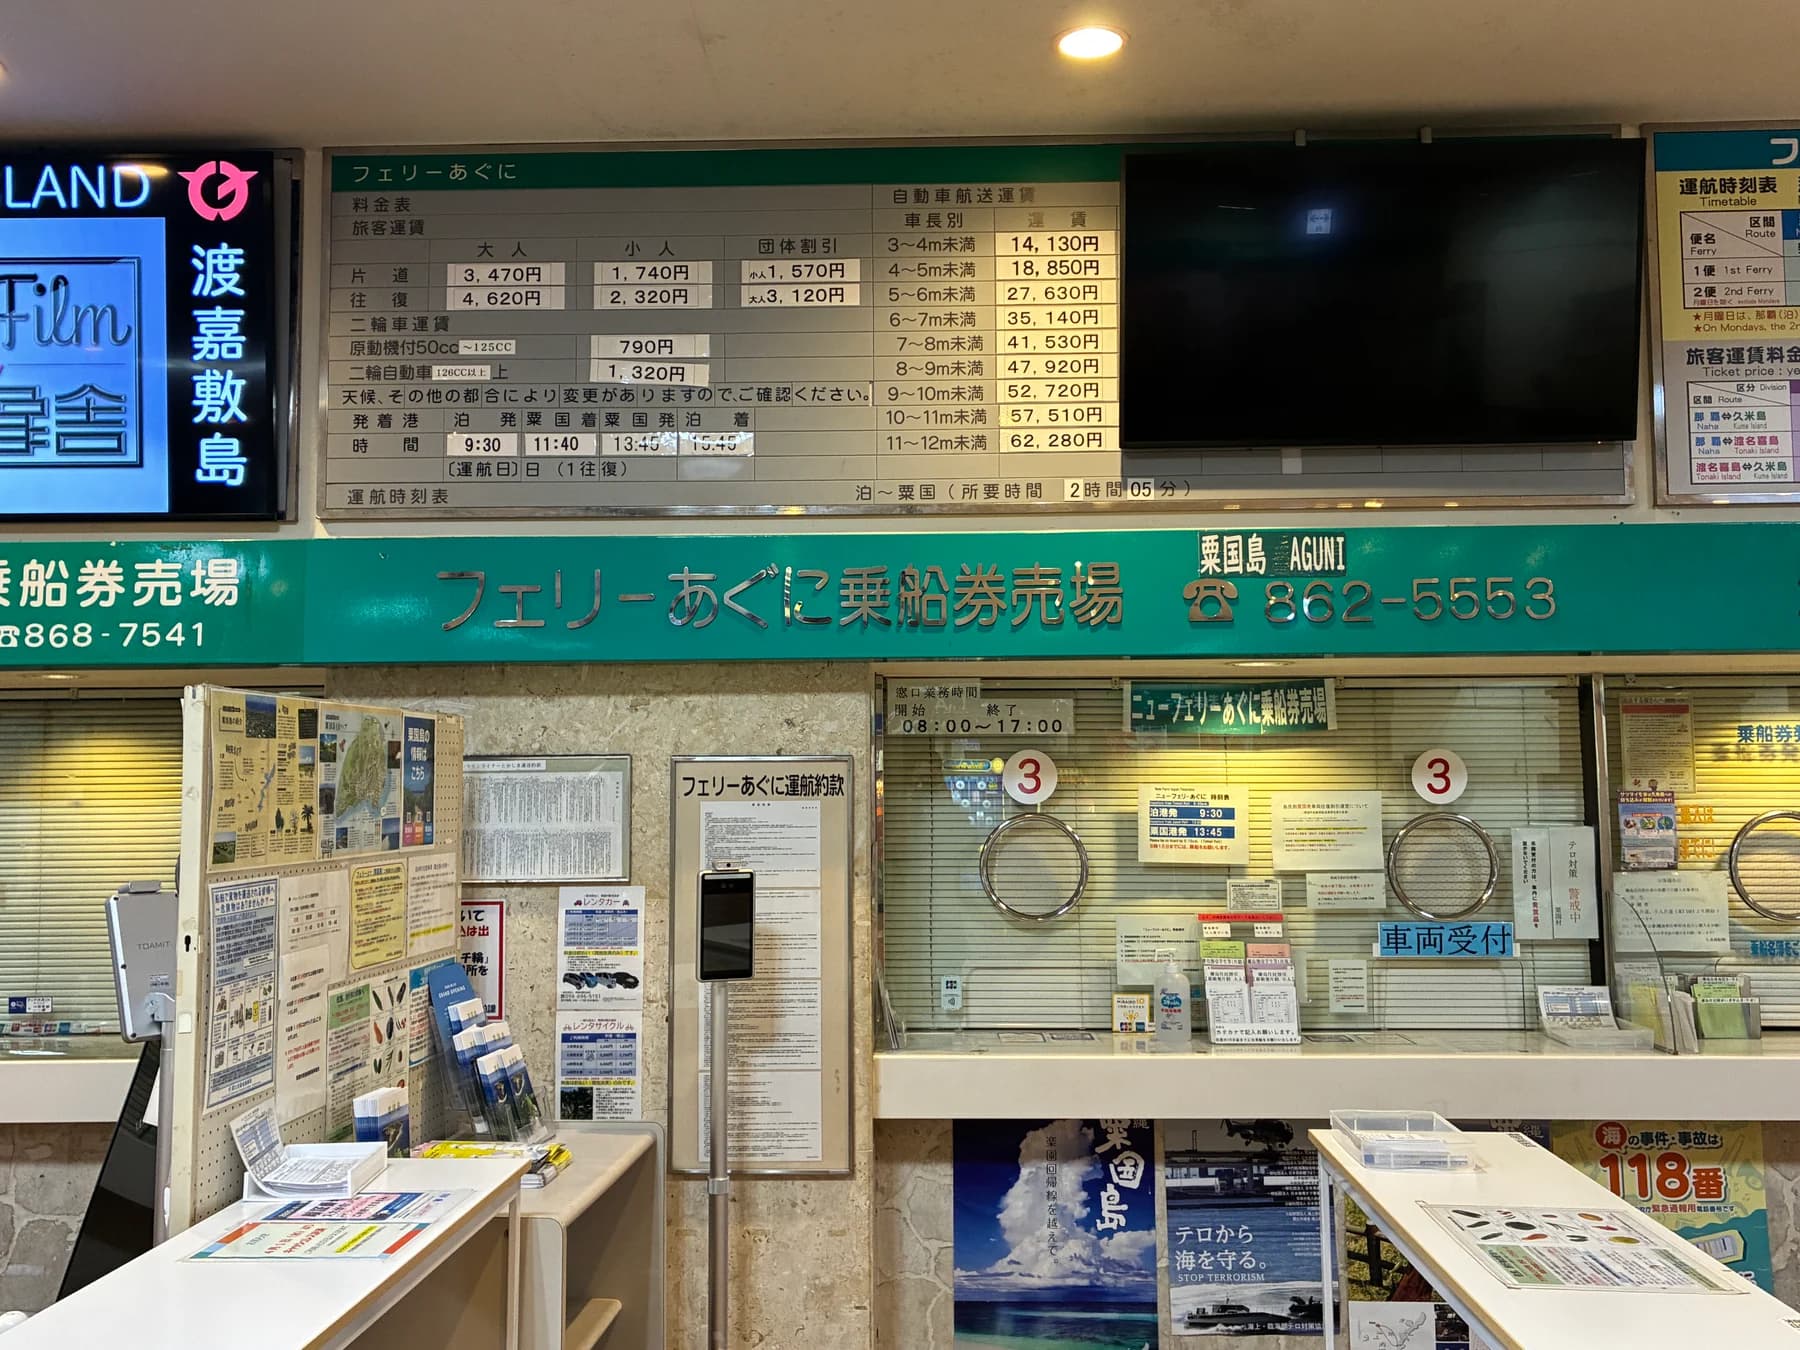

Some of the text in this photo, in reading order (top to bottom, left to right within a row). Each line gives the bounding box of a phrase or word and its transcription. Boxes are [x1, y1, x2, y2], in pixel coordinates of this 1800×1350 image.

[352, 162, 517, 183] フェリーあぐに
[5, 165, 151, 209] LAND
[1679, 176, 1777, 195] 運航時刻表
[352, 196, 411, 213] 料金表
[892, 187, 1036, 205] 自動車航送運賃
[1700, 197, 1757, 206] Timetable
[352, 219, 425, 236] 旅客運賃
[904, 212, 963, 229] 車長別
[1749, 216, 1775, 228] 区間
[1690, 233, 1716, 245] 便名
[1745, 229, 1776, 239] Route
[758, 237, 838, 254] 団体割引
[1690, 247, 1717, 256] Ferry
[1694, 265, 1773, 277] 1便 1st Ferry
[1693, 286, 1774, 298] 2便 2nd Ferry
[350, 315, 450, 332] 二輪車運賃
[1770, 322, 1786, 330] the
[620, 339, 673, 355] 790円
[191, 241, 248, 487] 渡嘉敷島
[1702, 366, 1740, 377] Ticket
[1745, 366, 1774, 379] price
[349, 365, 432, 382] 二輪自動車
[1718, 396, 1743, 404] Route
[352, 412, 419, 429] 発着港
[526, 411, 598, 428] 粟国着
[604, 411, 675, 428] 粟国発
[464, 437, 501, 452] 9:30
[533, 436, 579, 451] 11:40
[614, 436, 659, 452] 13:45
[347, 488, 449, 505] 運航時刻表
[1200, 533, 1345, 575] 粟国島 AGUNI
[0, 559, 239, 607] 船券売場
[437, 561, 1123, 631] フェリーあぐに乗船券売場
[1264, 577, 1556, 623] 862-5553
[24, 621, 205, 648] 868-7541
[895, 686, 978, 699] 窓口業務時間
[895, 703, 1017, 717] 開始 終了
[1131, 687, 1327, 727] ニューフェリーあぐに乗船券売場
[1017, 758, 1041, 794] 3
[1427, 758, 1451, 794] 3
[682, 773, 844, 797] フェリーあぐに運航約款
[1199, 809, 1223, 818] 9:30
[1194, 827, 1223, 837] 13:45
[583, 898, 621, 906] レンタカー
[1382, 924, 1512, 956] 車両受付
[573, 1022, 625, 1030] レンタサイクル
[1600, 1152, 1724, 1199] 118番
[1175, 1224, 1254, 1245] テロから
[1175, 1249, 1267, 1272] 海を守る。
[1178, 1272, 1265, 1283] STOP TERRORISM
